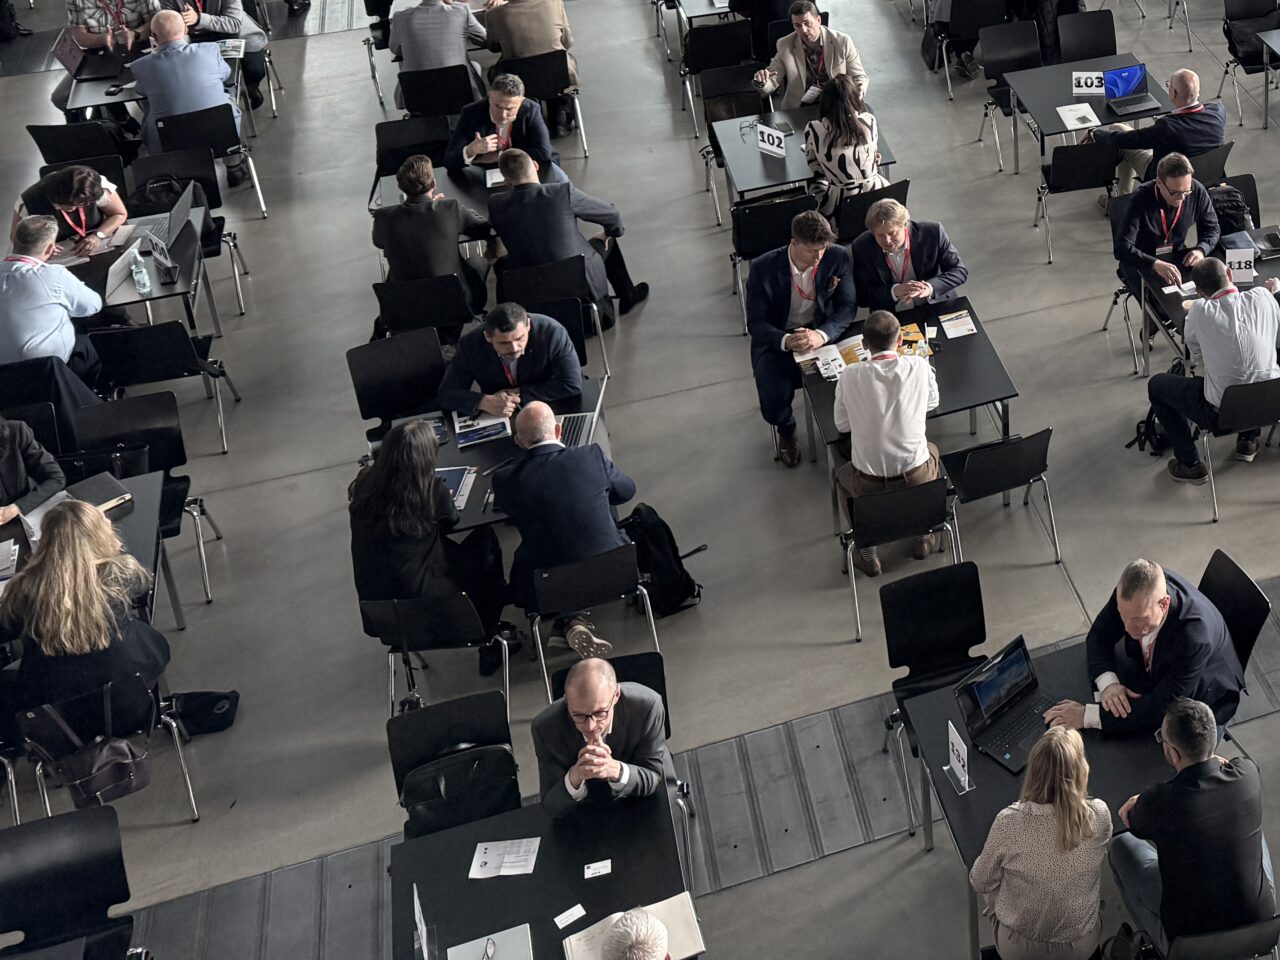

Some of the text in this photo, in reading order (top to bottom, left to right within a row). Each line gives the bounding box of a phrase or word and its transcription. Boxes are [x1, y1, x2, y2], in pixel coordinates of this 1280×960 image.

[1074, 76, 1104, 90] 103
[759, 129, 784, 150] 102
[1227, 258, 1252, 271] 118
[951, 742, 968, 770] 132
